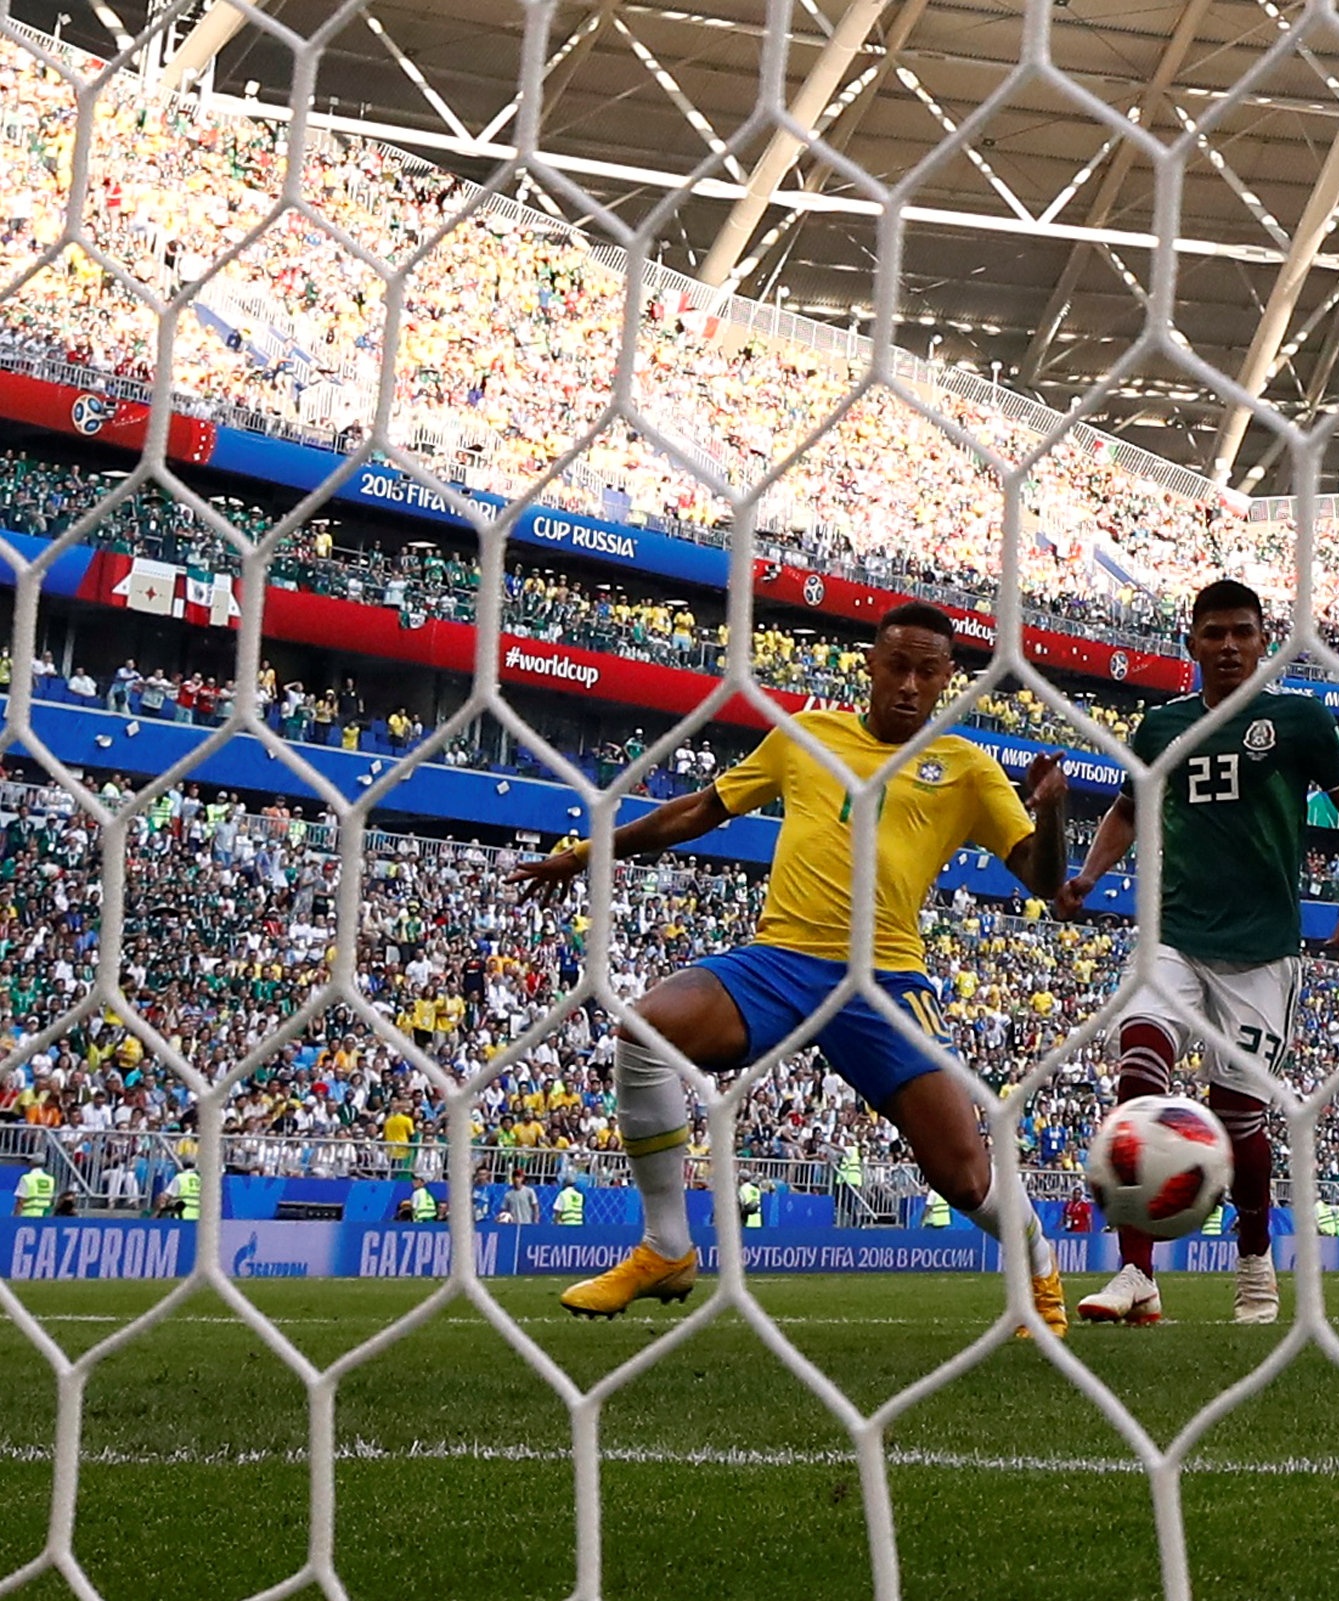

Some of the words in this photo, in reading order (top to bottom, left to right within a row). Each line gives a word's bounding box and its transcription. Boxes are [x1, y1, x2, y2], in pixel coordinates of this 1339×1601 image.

[406, 483, 446, 513] FIFA
[533, 516, 570, 542] CUP
[572, 525, 635, 558] RUSSIA
[505, 646, 599, 689] #worldcup
[1062, 760, 1120, 784] ФУТБОЛУ
[1188, 754, 1240, 803] 23
[11, 1227, 181, 1279] GAZPROM
[360, 1231, 498, 1276] GAZPRM
[822, 1246, 854, 1268] FIFA
[858, 1248, 894, 1268] 2018
[909, 1248, 974, 1268] РОССИИ
